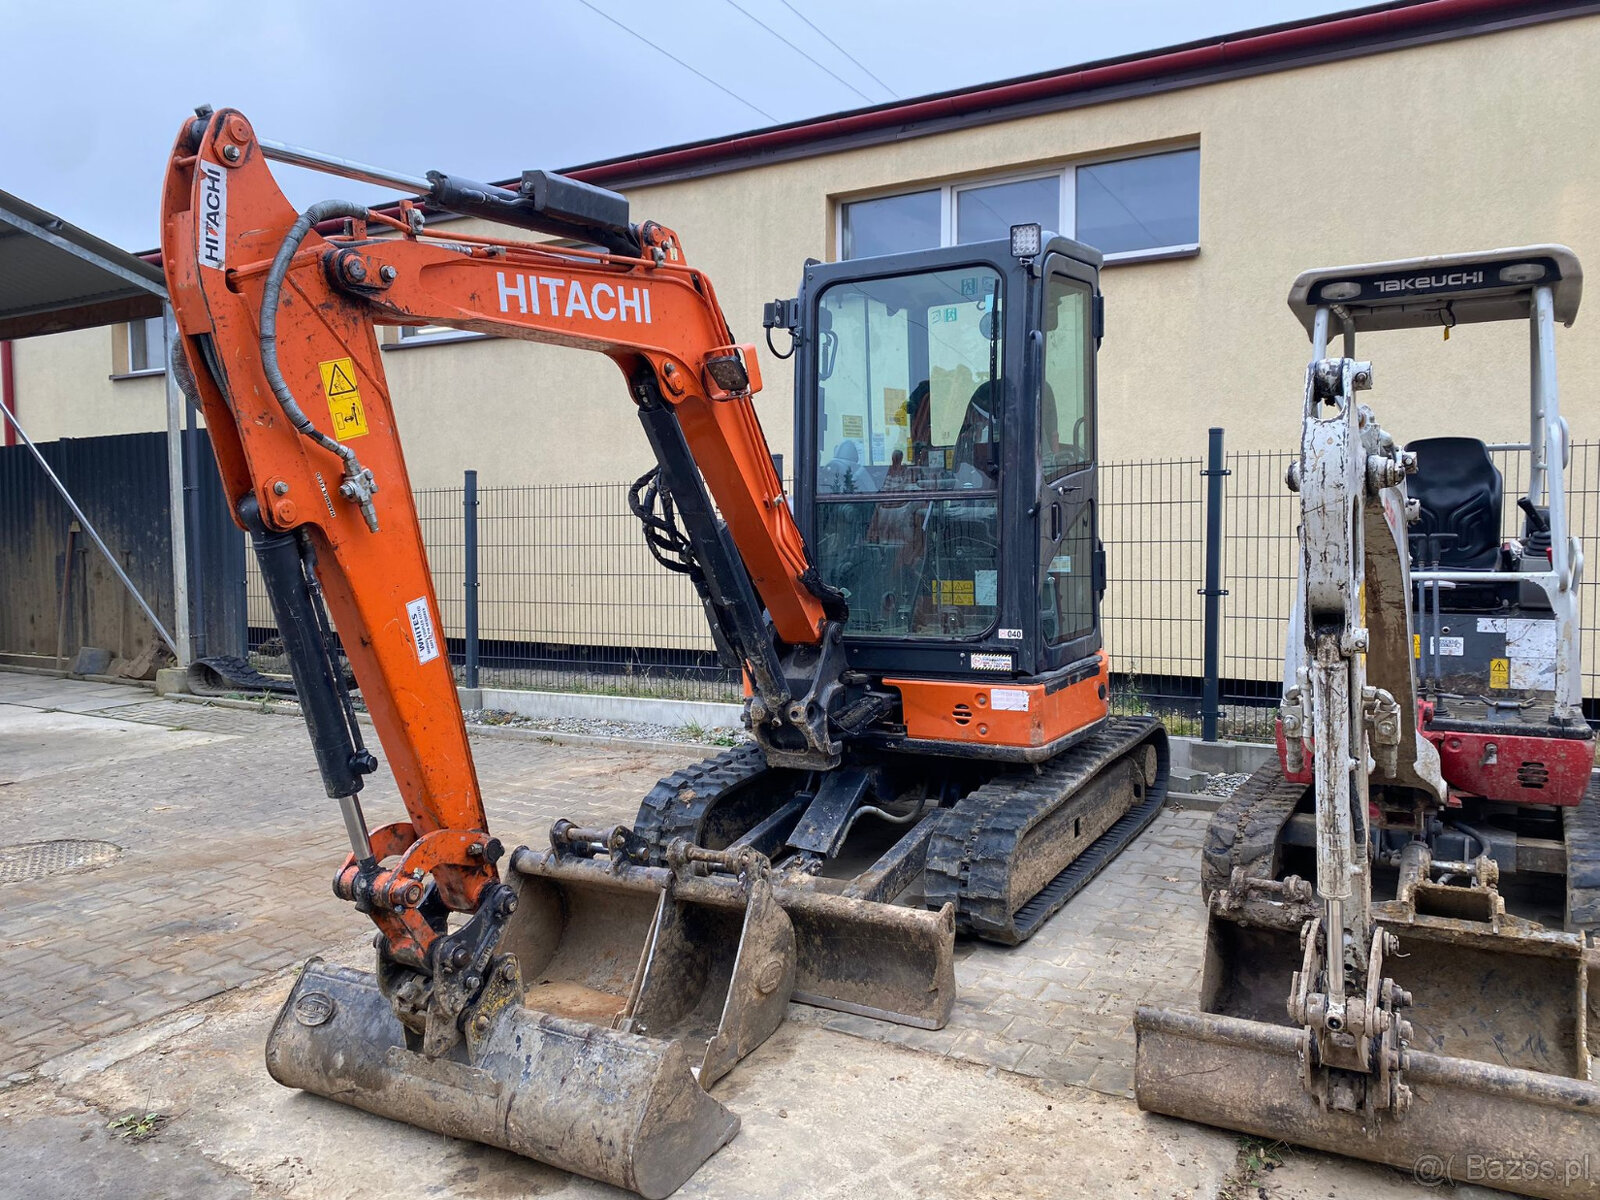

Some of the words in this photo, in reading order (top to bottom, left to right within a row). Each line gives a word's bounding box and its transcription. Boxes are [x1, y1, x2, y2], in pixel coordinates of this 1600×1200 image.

[204, 168, 223, 264] HITACHI
[497, 271, 651, 324] HITACHI
[411, 613, 425, 652] WHITES
